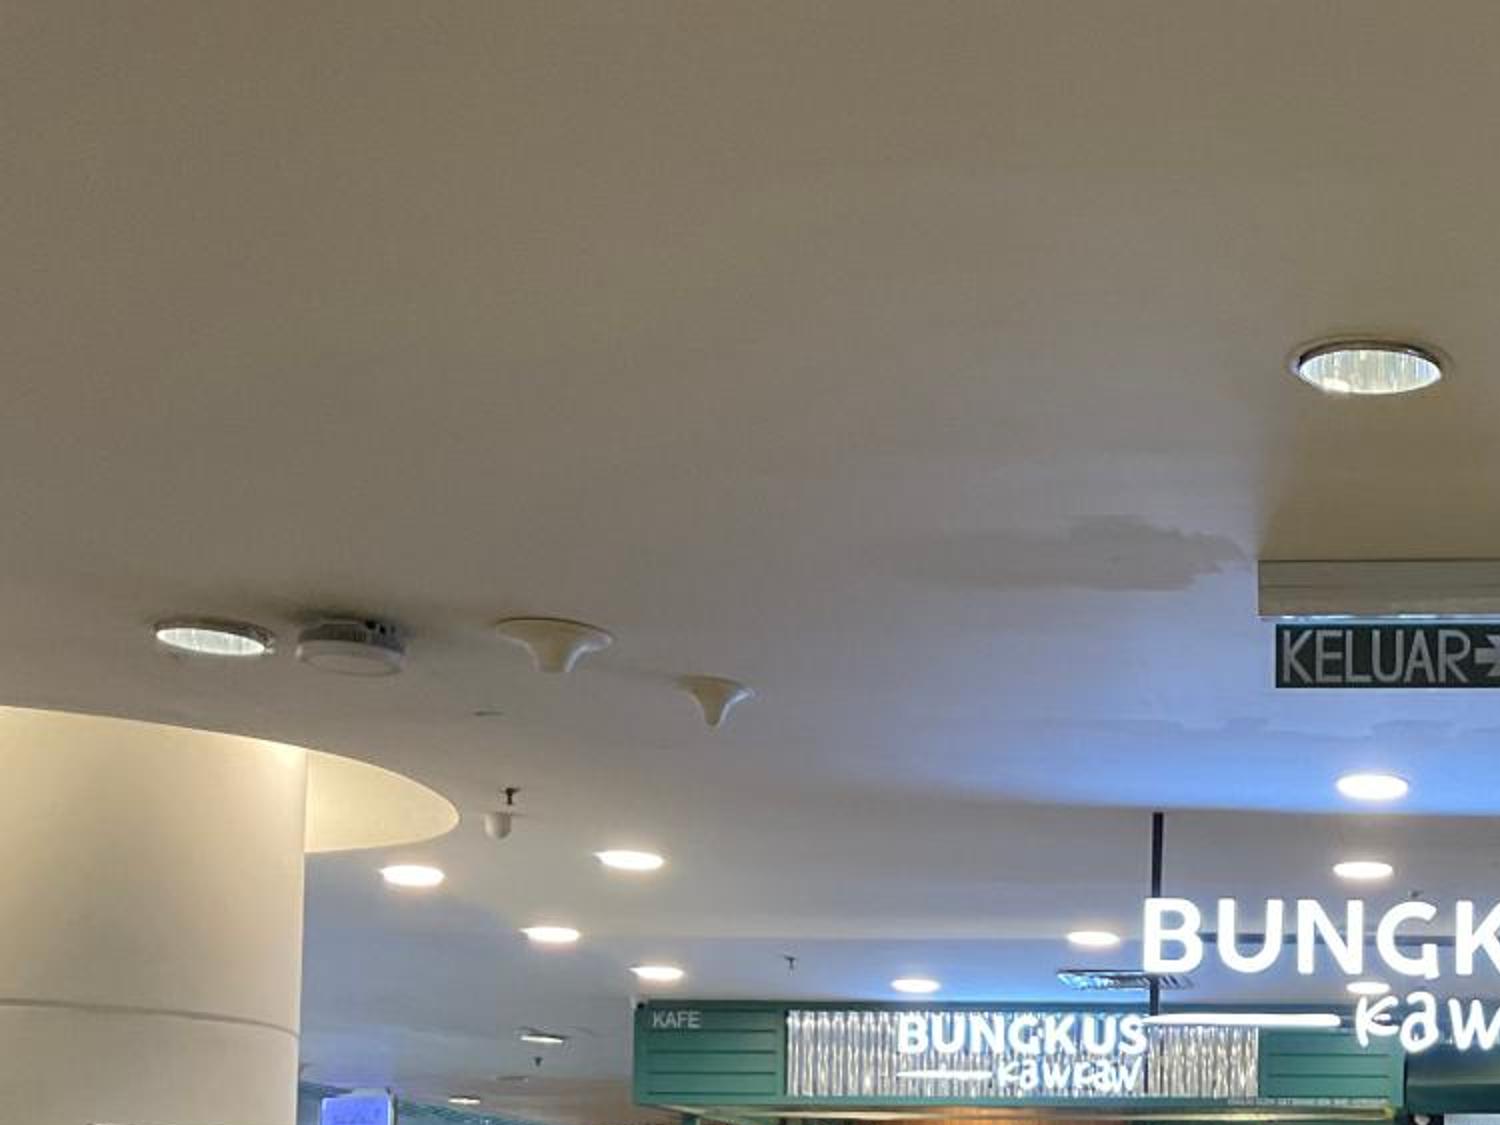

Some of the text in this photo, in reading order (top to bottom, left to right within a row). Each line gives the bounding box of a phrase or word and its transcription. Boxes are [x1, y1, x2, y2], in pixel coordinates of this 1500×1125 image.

[1282, 629, 1472, 684] KELUAR
[652, 1010, 702, 1029] KAFE
[898, 1013, 1148, 1055] BUNGKUS
